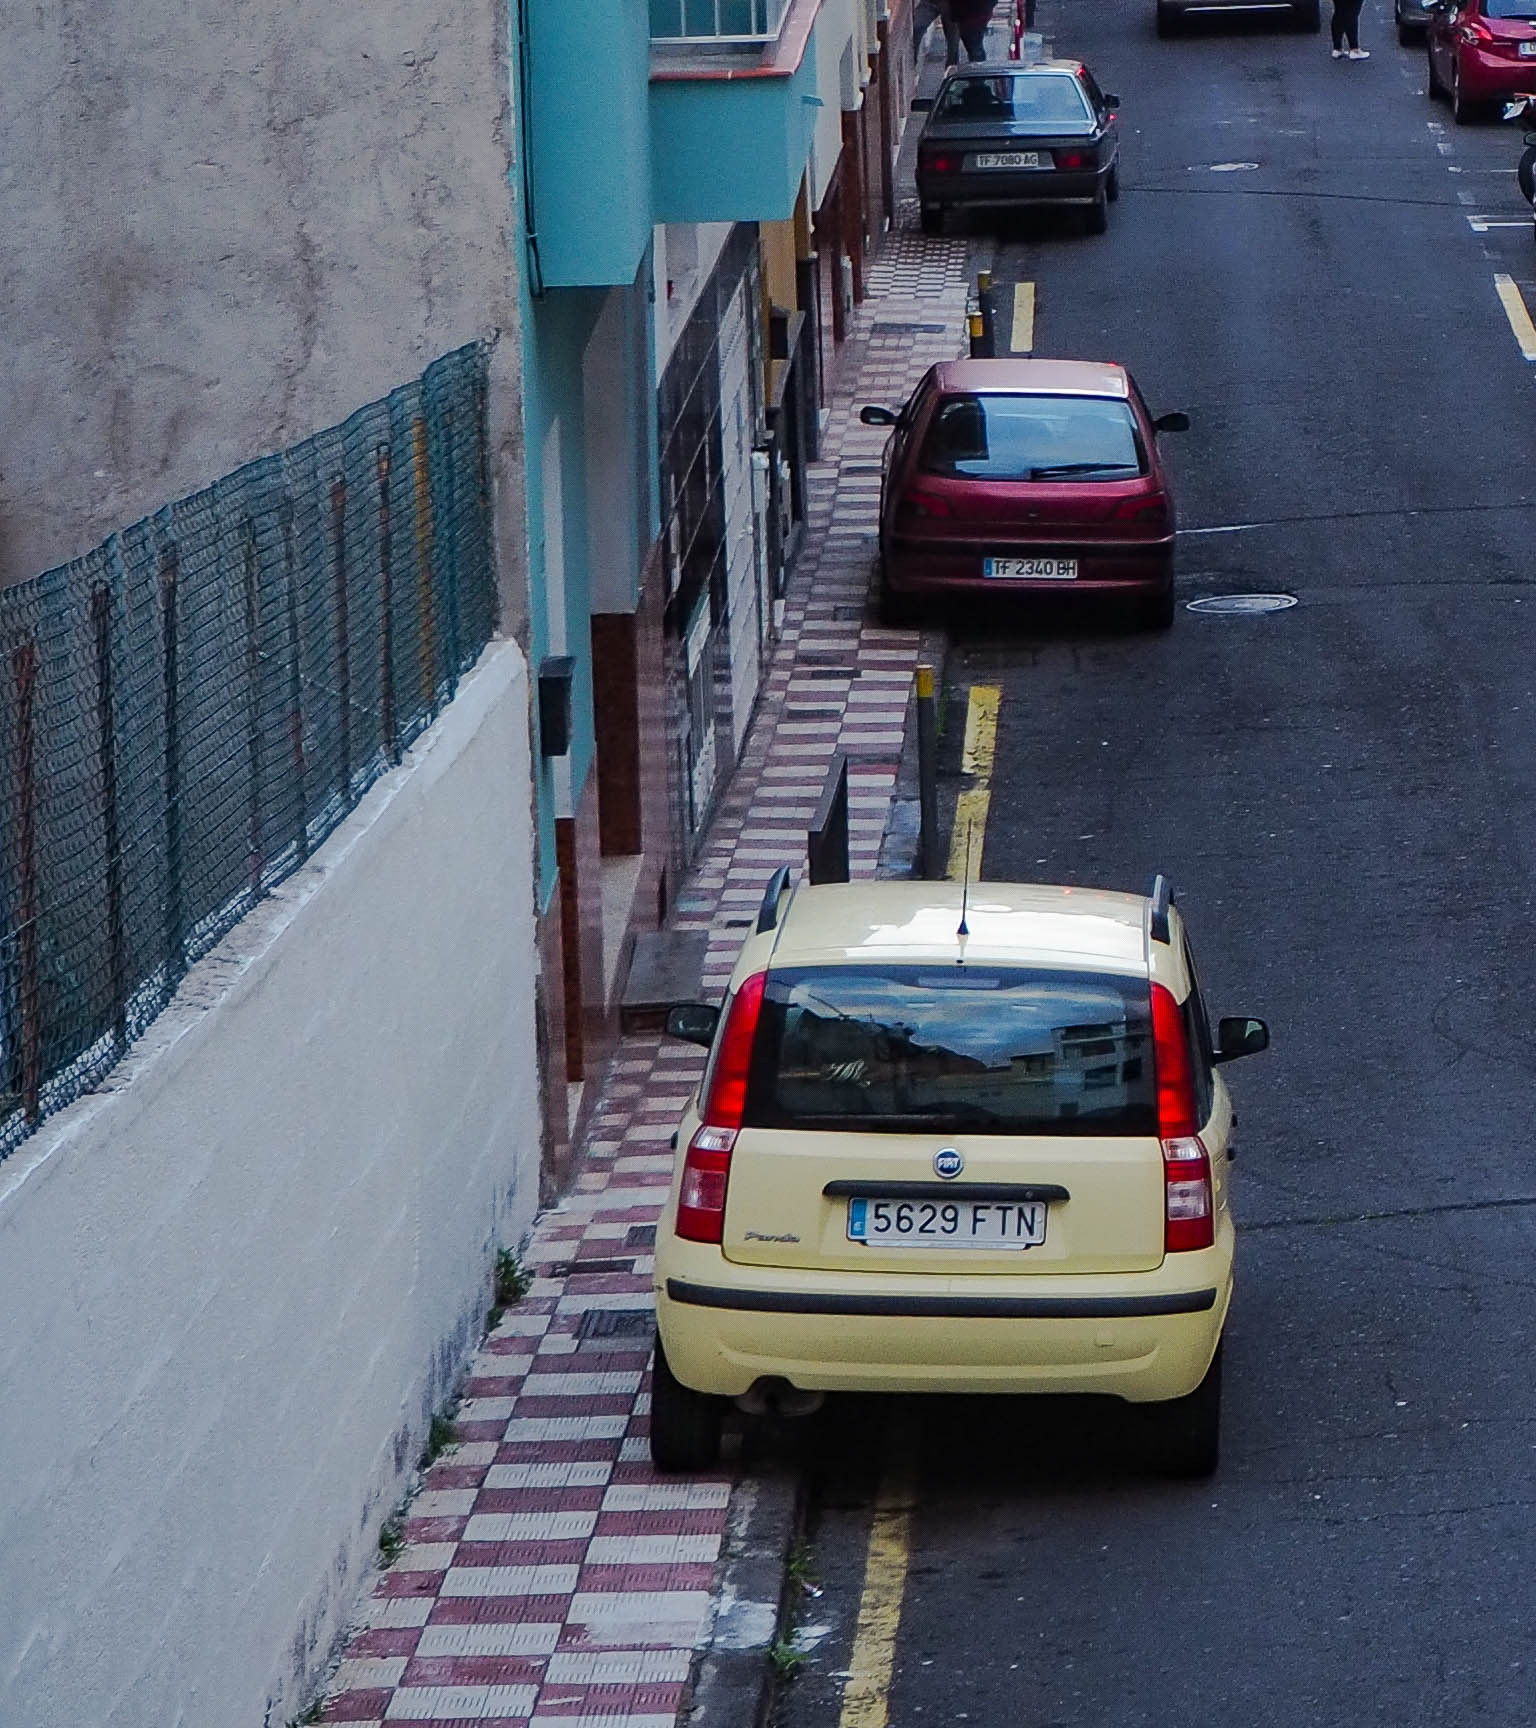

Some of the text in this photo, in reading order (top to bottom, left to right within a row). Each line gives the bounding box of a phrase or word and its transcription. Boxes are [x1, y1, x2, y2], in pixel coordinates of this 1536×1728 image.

[993, 559, 1010, 575] TF
[1015, 559, 1054, 576] 2340
[937, 1156, 961, 1170] FIAT
[873, 1202, 1037, 1237] 5629 FTN
